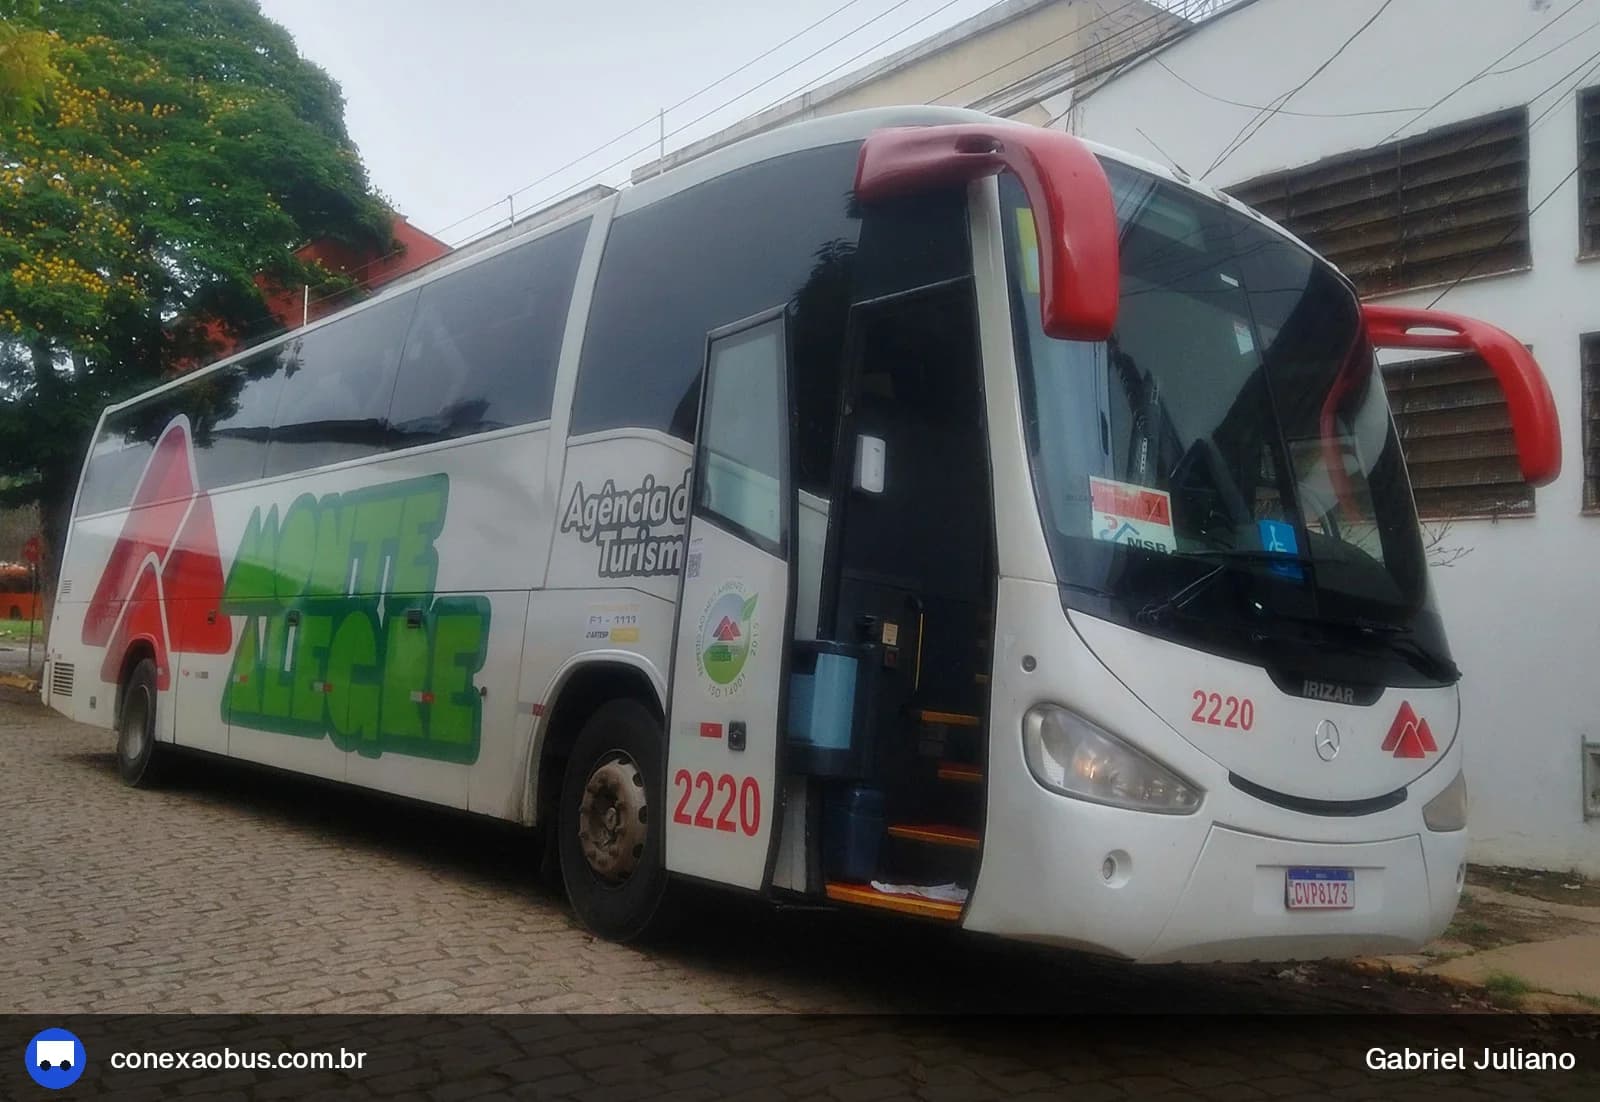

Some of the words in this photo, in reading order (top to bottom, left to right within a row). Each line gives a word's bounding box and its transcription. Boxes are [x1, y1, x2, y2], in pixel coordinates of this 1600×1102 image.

[561, 474, 669, 543] Agência
[670, 468, 693, 525] d
[220, 472, 449, 615] MONTE
[597, 525, 684, 578] Turism
[220, 595, 491, 765] ALEGRE
[1303, 679, 1355, 704] IRIZAR
[1191, 690, 1255, 731] 2220
[673, 769, 761, 837] 2220
[1295, 882, 1348, 905] CVP8173
